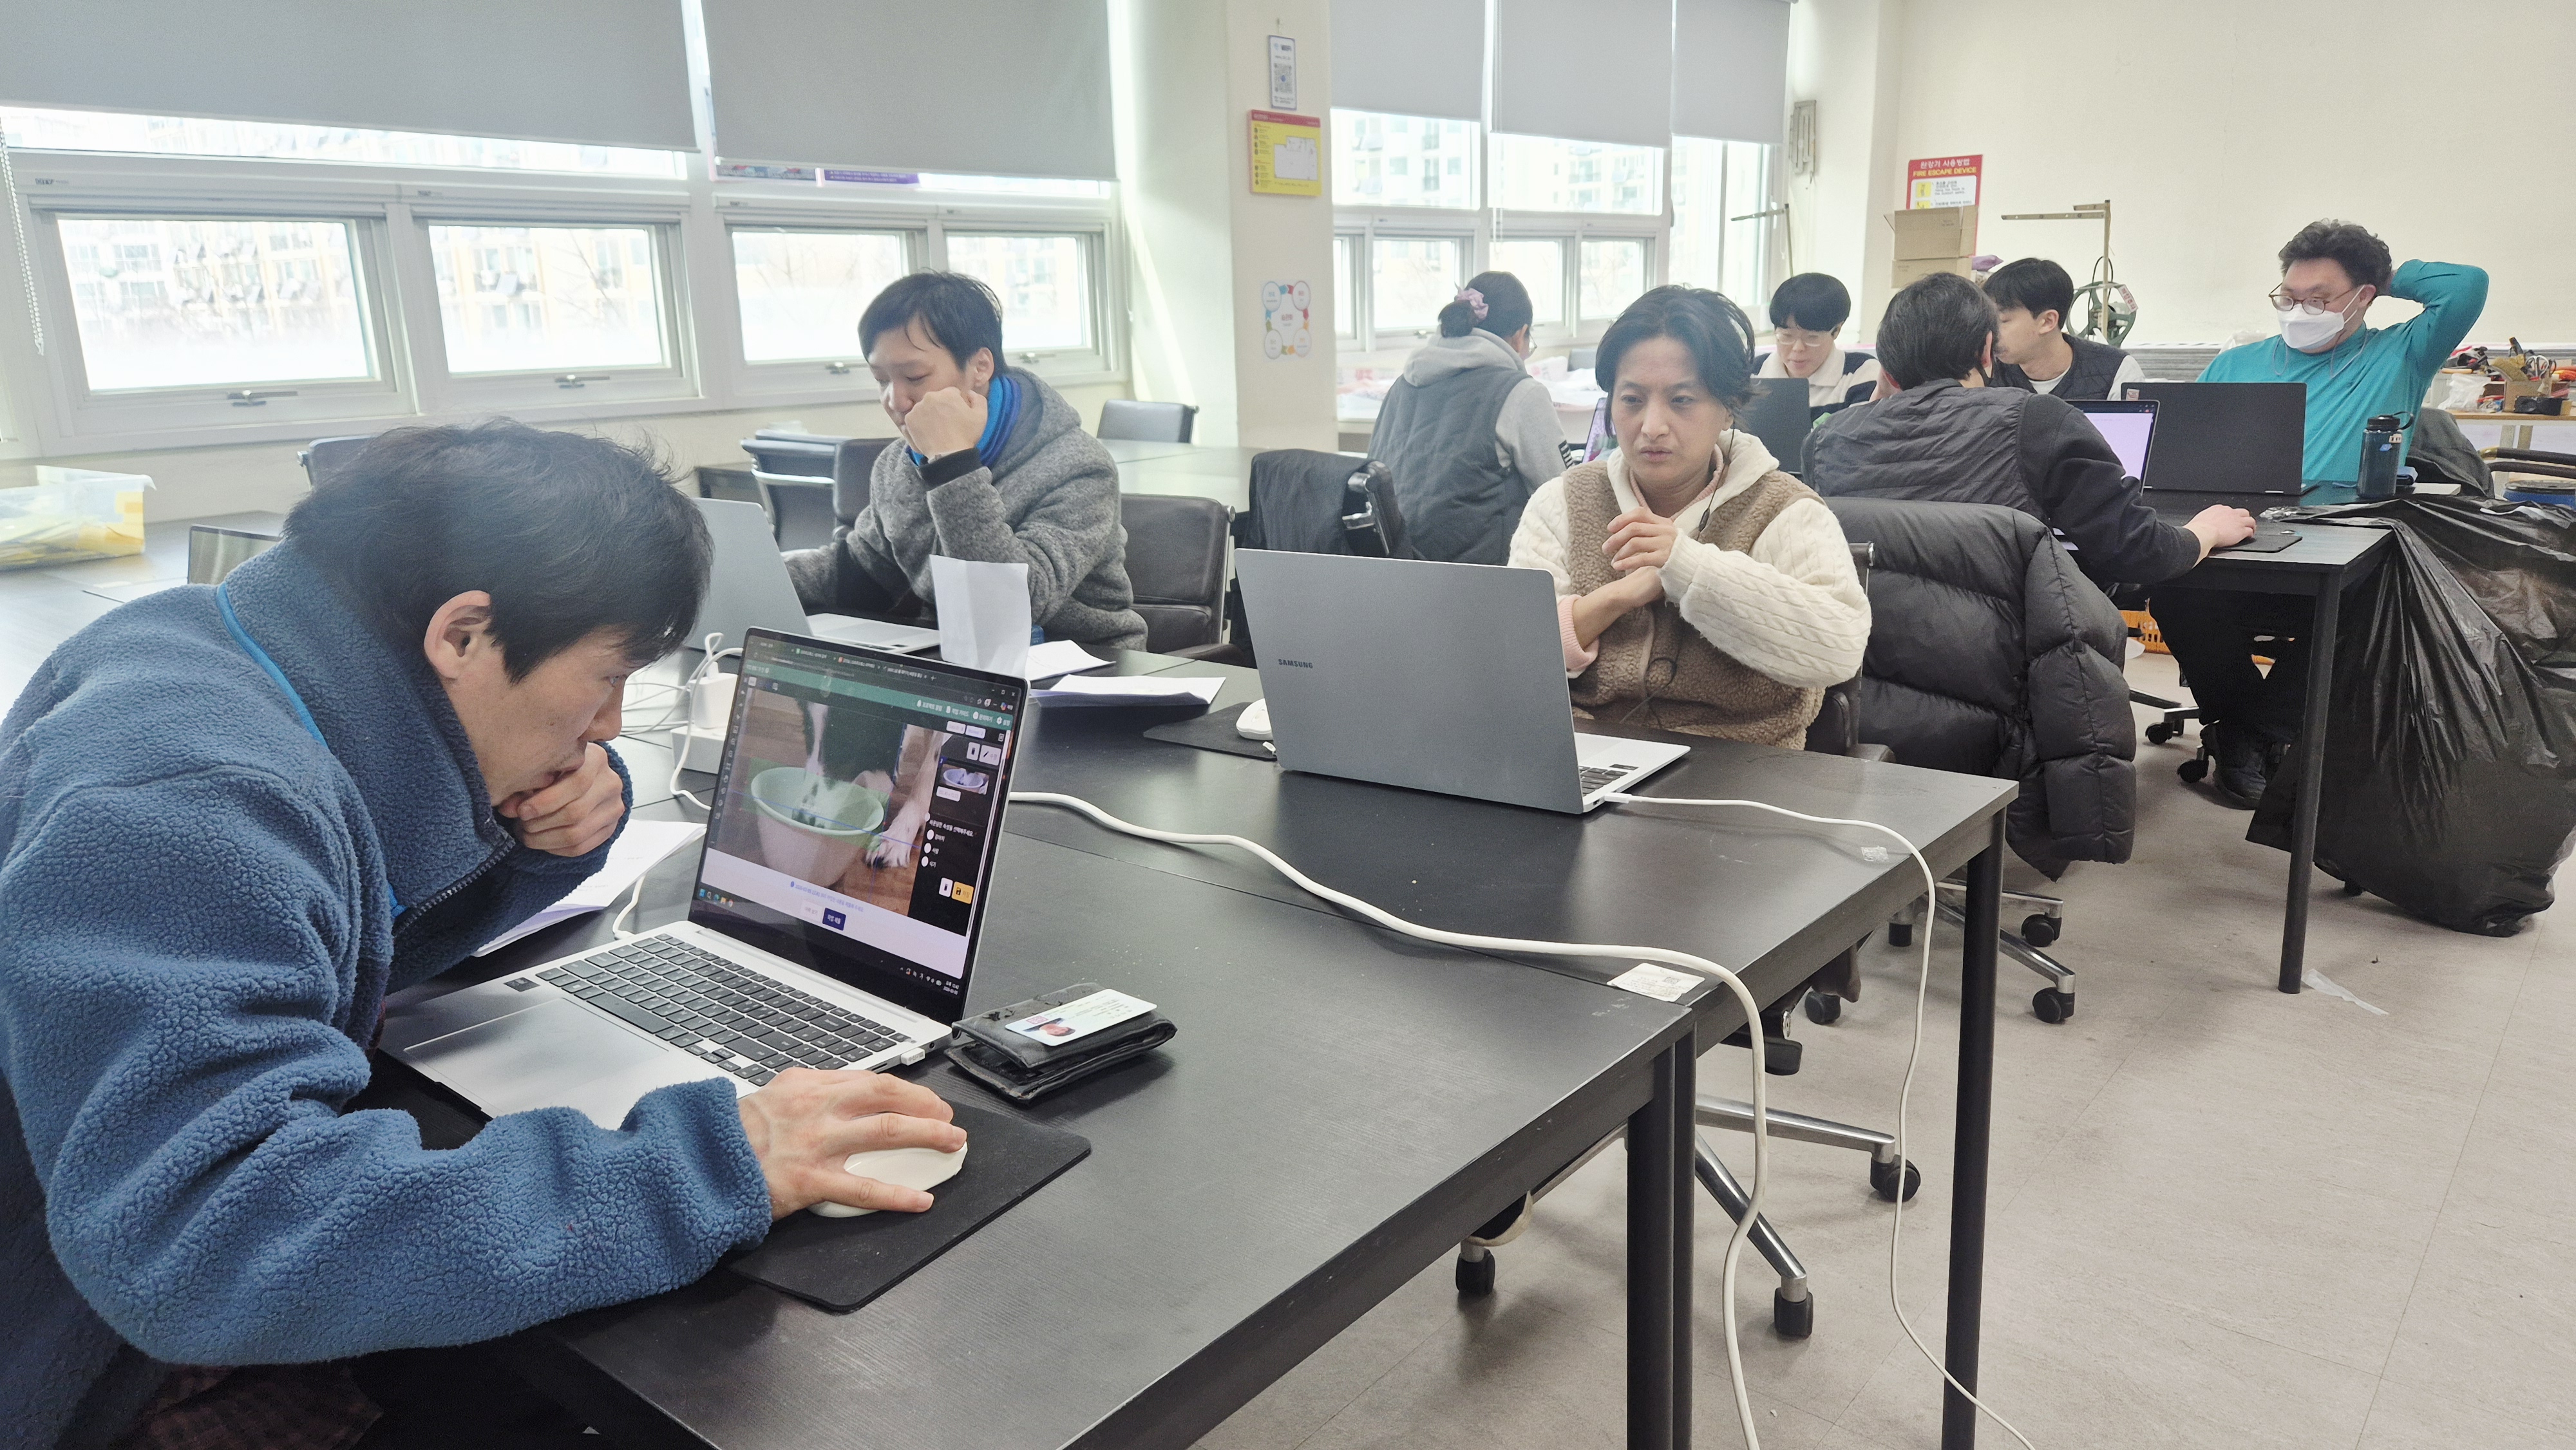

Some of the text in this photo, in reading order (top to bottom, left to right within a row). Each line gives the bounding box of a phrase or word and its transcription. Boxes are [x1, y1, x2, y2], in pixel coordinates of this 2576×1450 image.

[1942, 158, 1971, 167] 사용방법
[1927, 168, 1952, 176] ESCAPE
[1278, 658, 1313, 669] SAMSUNG
